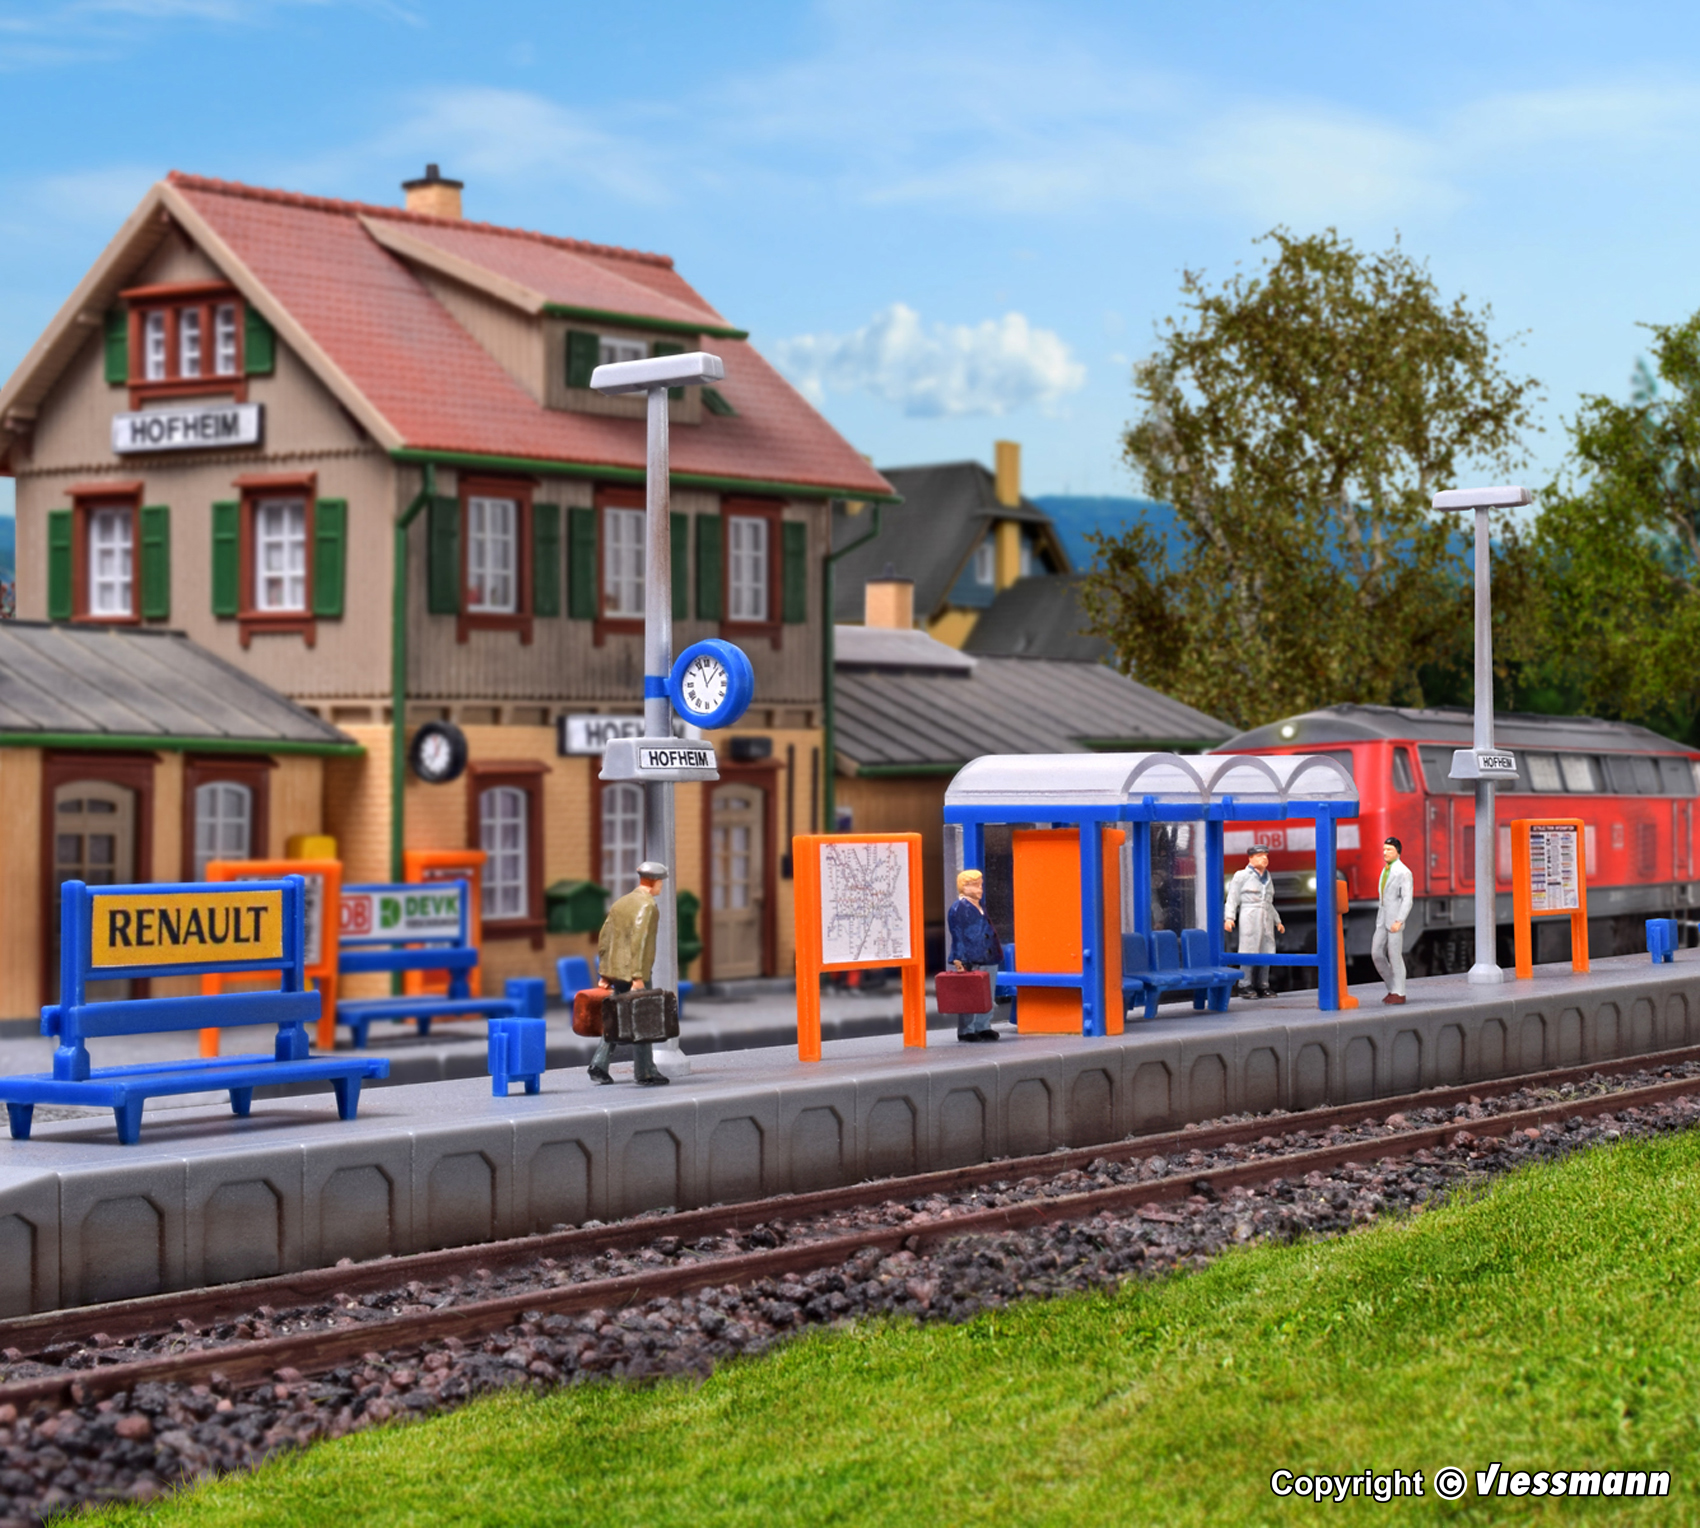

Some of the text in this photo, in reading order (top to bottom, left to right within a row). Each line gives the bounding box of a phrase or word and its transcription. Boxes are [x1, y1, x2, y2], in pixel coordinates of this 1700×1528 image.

[131, 411, 239, 444] HOFHEIM
[648, 750, 709, 767] HOFHEIM
[1259, 833, 1282, 849] DB
[108, 906, 269, 948] RENAULT
[340, 895, 458, 929] DB DEVK
